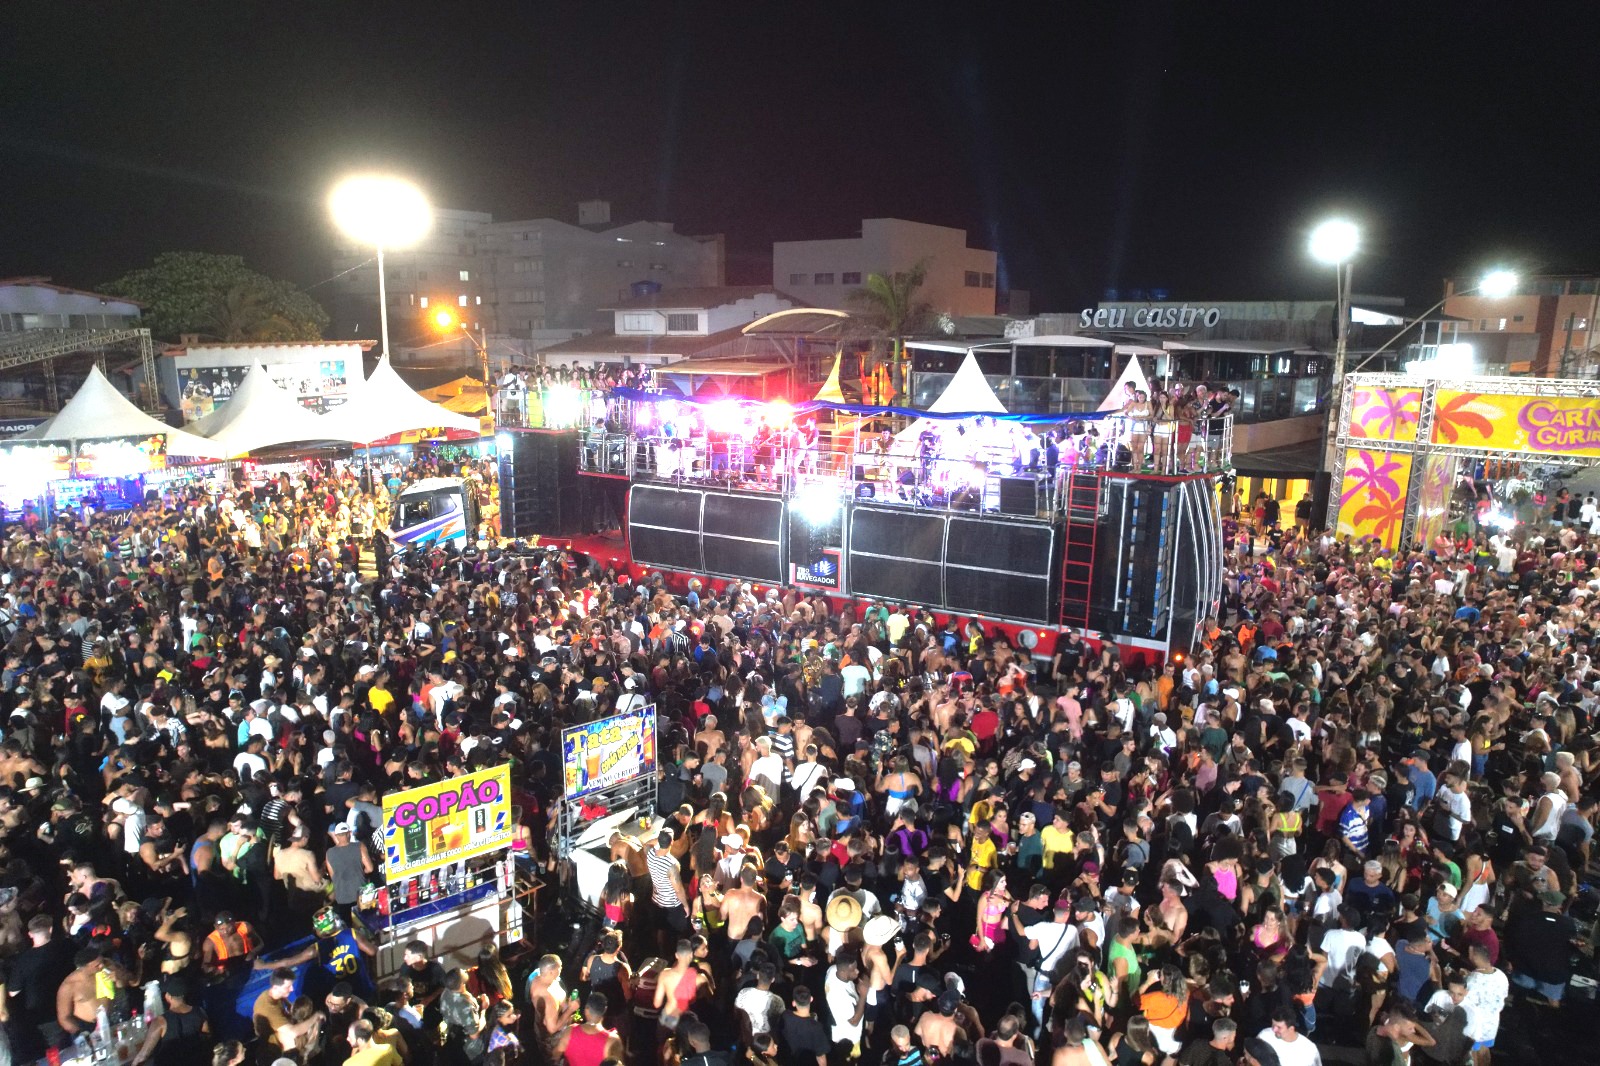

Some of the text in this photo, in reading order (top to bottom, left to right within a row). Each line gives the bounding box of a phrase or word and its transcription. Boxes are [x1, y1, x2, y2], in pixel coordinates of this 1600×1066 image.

[1079, 303, 1221, 328] seu castro
[566, 725, 622, 754] Tata
[394, 779, 500, 828] COPÃO
